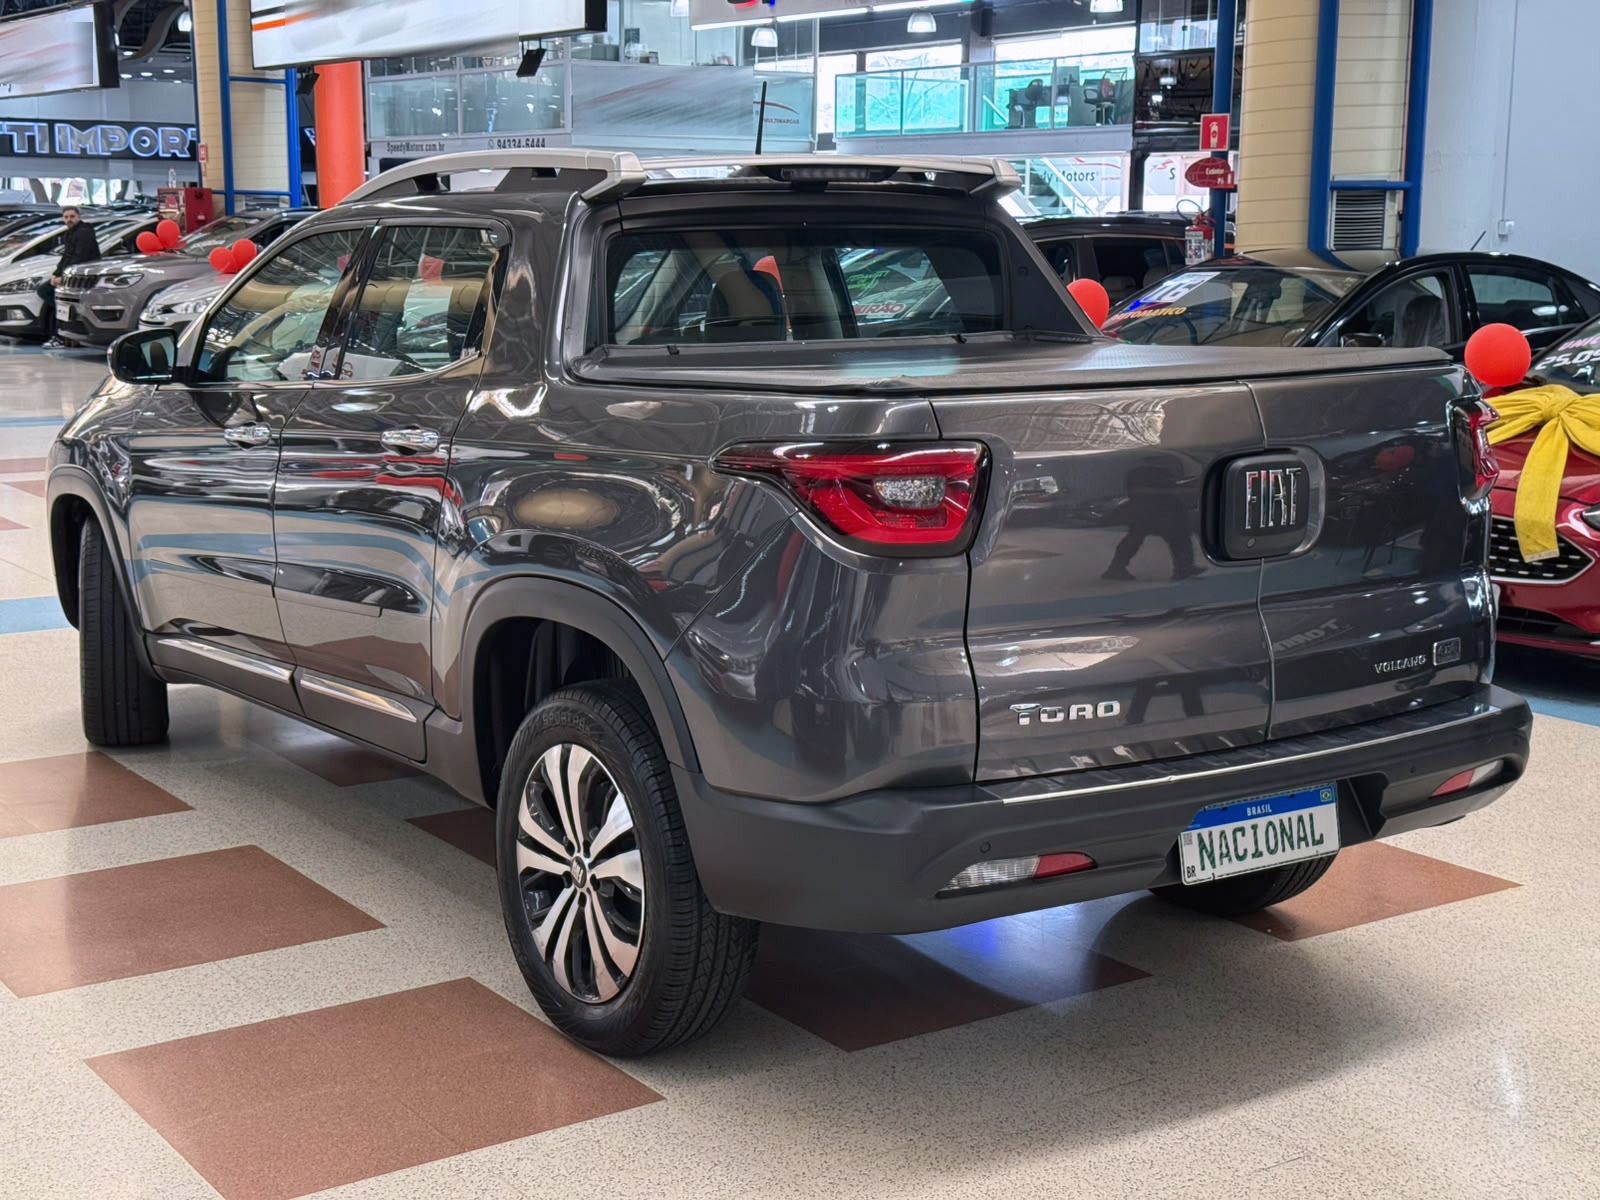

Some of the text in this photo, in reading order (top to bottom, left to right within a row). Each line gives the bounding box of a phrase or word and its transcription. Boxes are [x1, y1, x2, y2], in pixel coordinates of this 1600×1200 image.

[1245, 467, 1302, 529] FIAT
[1374, 655, 1427, 674] VOLCANO
[1008, 700, 1121, 726] TORO
[1246, 803, 1273, 817] BRASIL
[1196, 812, 1324, 872] NACIONAL
[1186, 865, 1197, 879] BR
